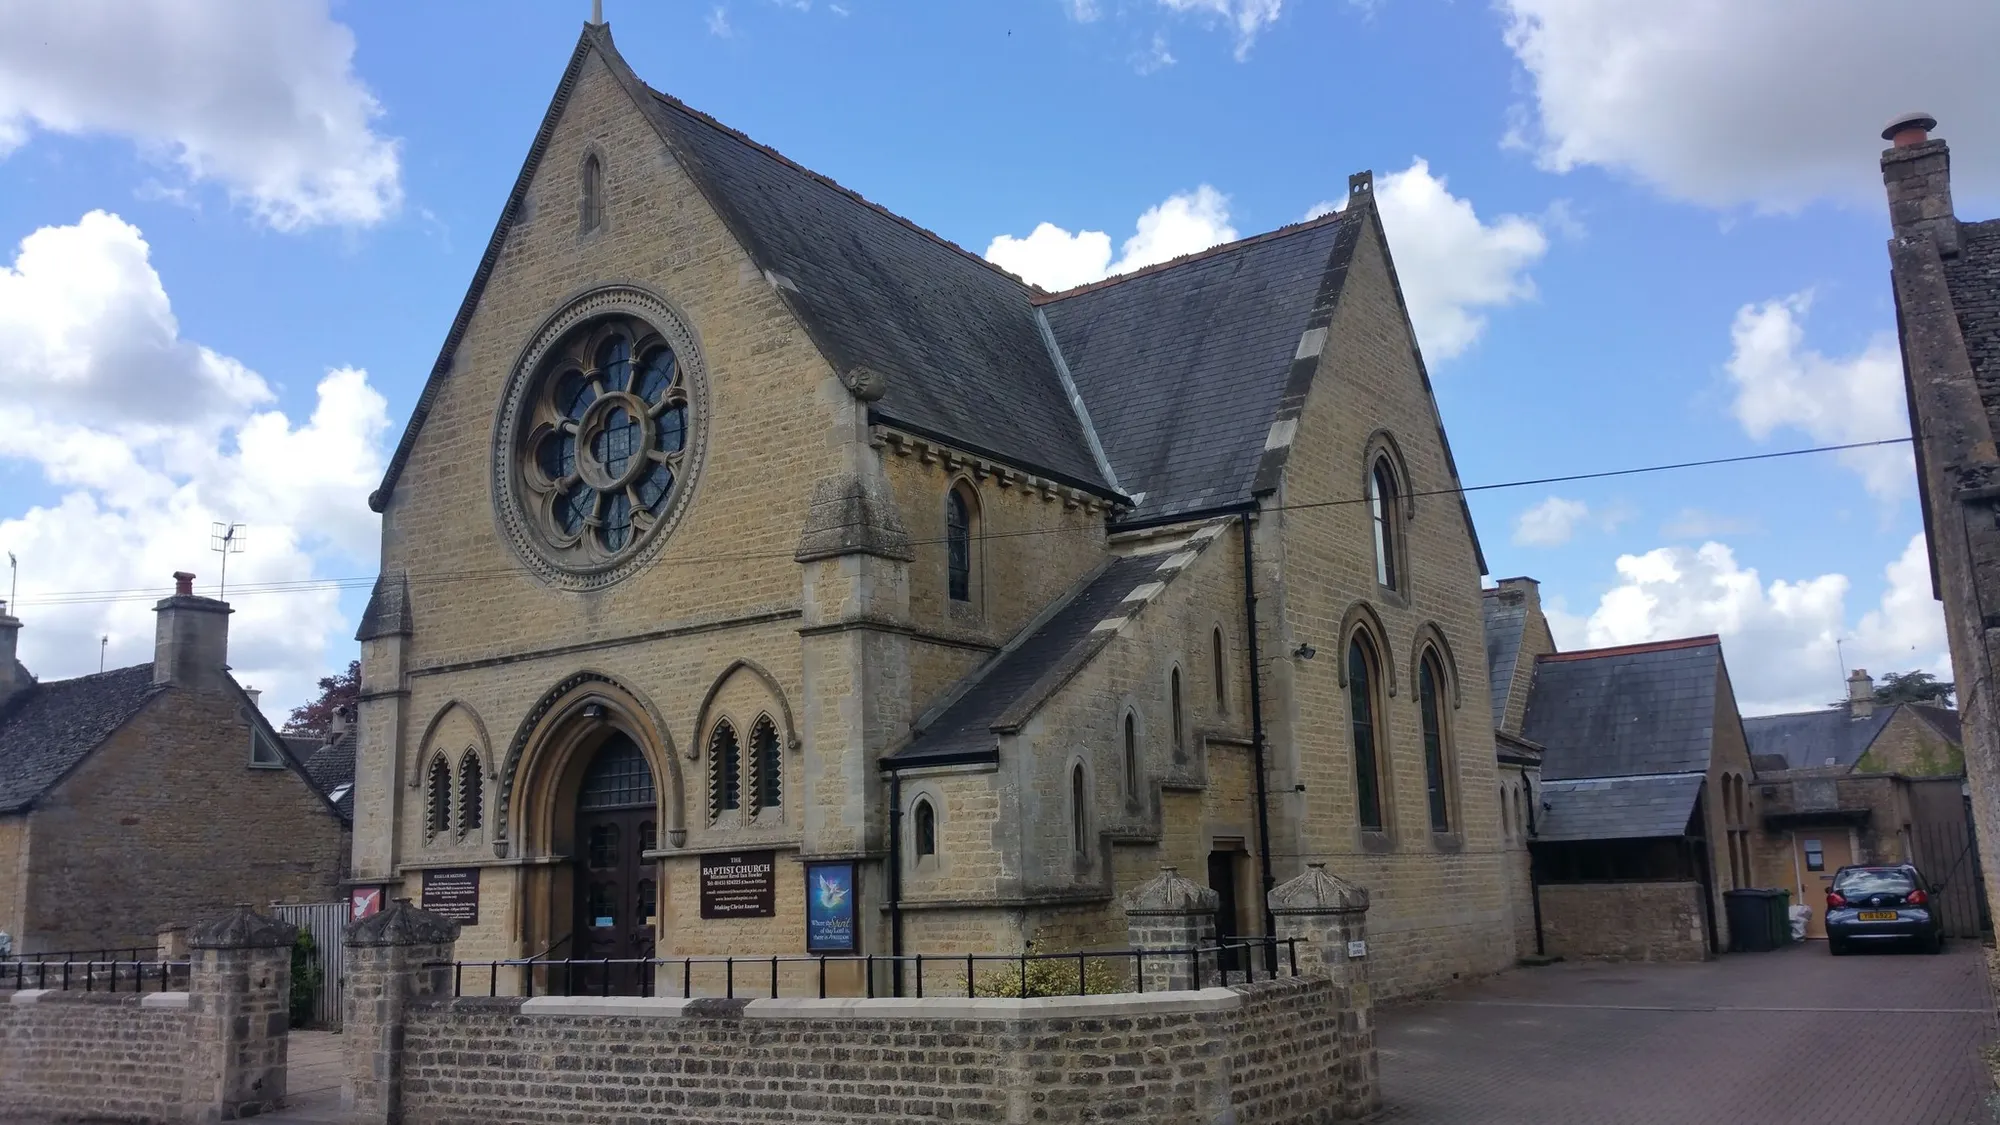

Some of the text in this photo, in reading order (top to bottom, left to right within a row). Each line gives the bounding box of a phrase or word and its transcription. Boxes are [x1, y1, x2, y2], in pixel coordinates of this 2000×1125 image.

[703, 864, 770, 876] BAPTIST CHURCH
[832, 916, 852, 928] Spirit
